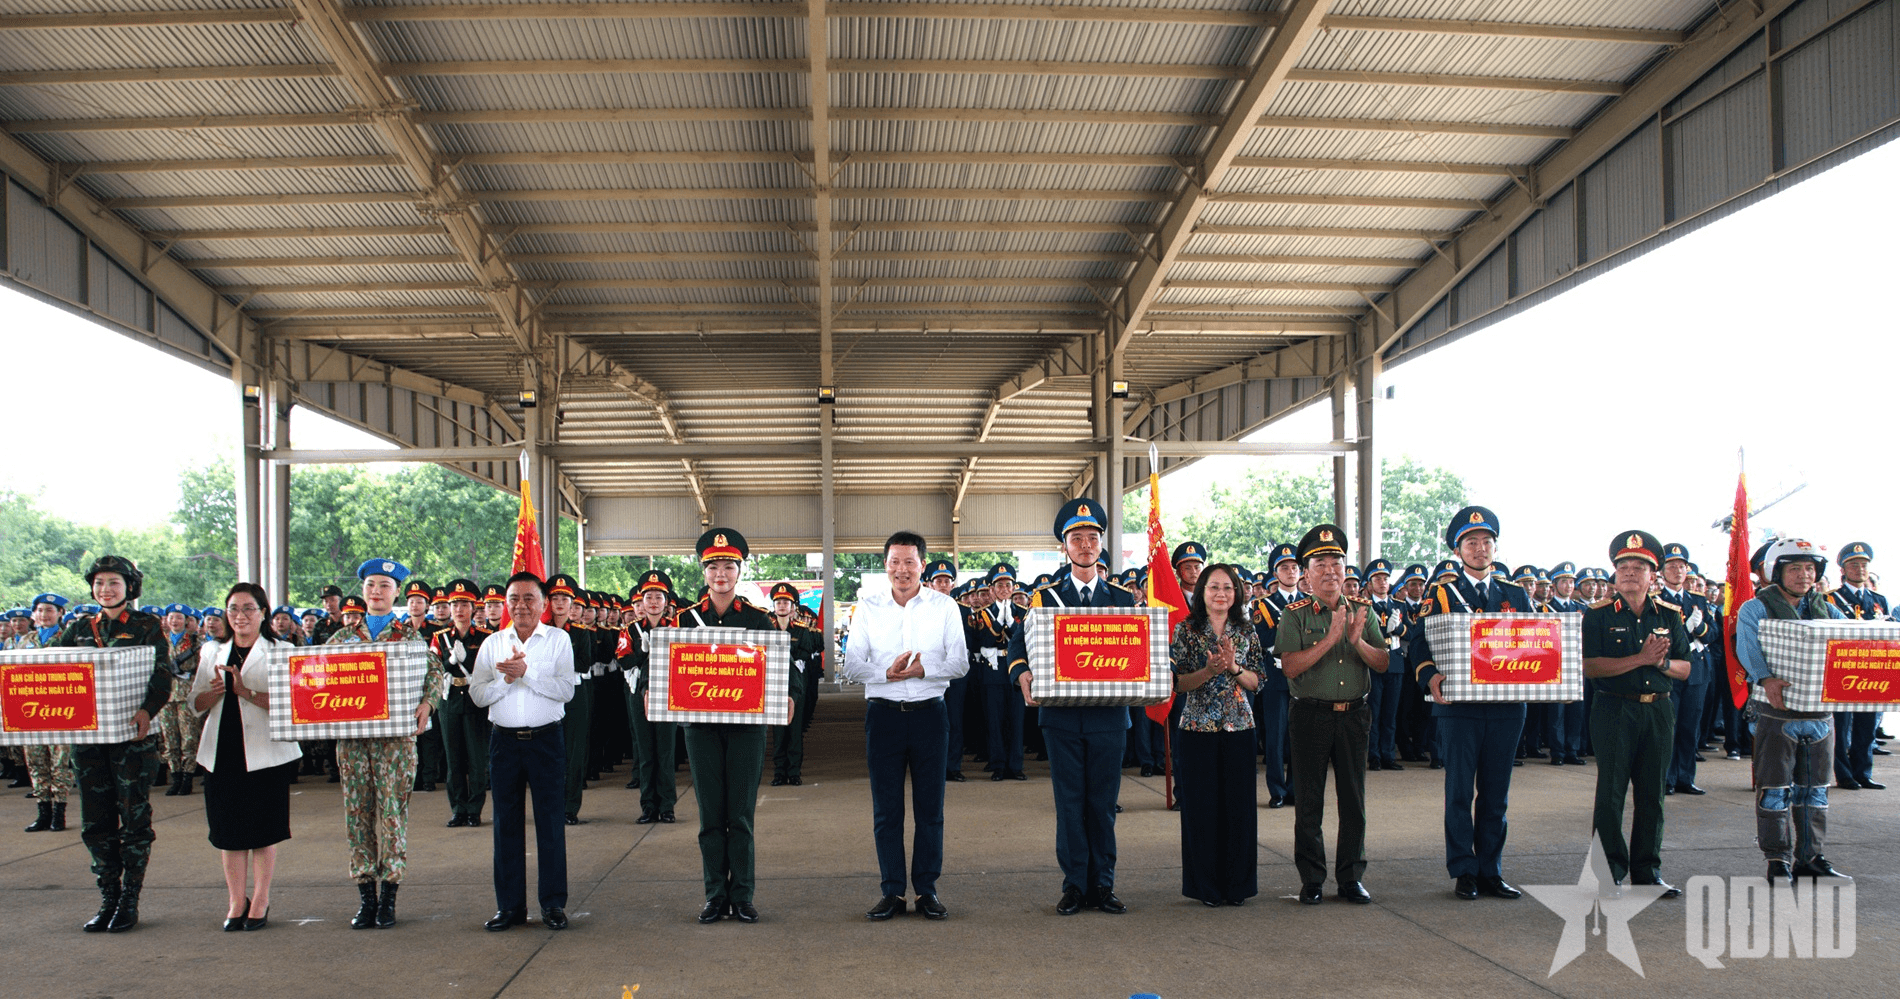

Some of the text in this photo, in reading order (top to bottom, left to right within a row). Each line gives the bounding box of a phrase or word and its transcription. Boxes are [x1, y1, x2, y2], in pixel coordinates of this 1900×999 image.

[1066, 624, 1078, 632] BAN
[1080, 622, 1089, 632] CHỈ
[1090, 636, 1102, 645] CÁC
[1104, 636, 1119, 645] NGÀY
[681, 653, 693, 661] BAN
[695, 651, 704, 662] CHỈ
[719, 654, 737, 663] TRUNG
[1075, 652, 1130, 670] Tặng
[1491, 655, 1542, 673] Tặng
[705, 666, 717, 675] CÁC
[719, 666, 734, 676] NGÀY
[689, 682, 744, 701] Tặng
[1841, 676, 1890, 693] Tặng
[312, 693, 368, 711] Tặng
[21, 702, 76, 720] Tặng
